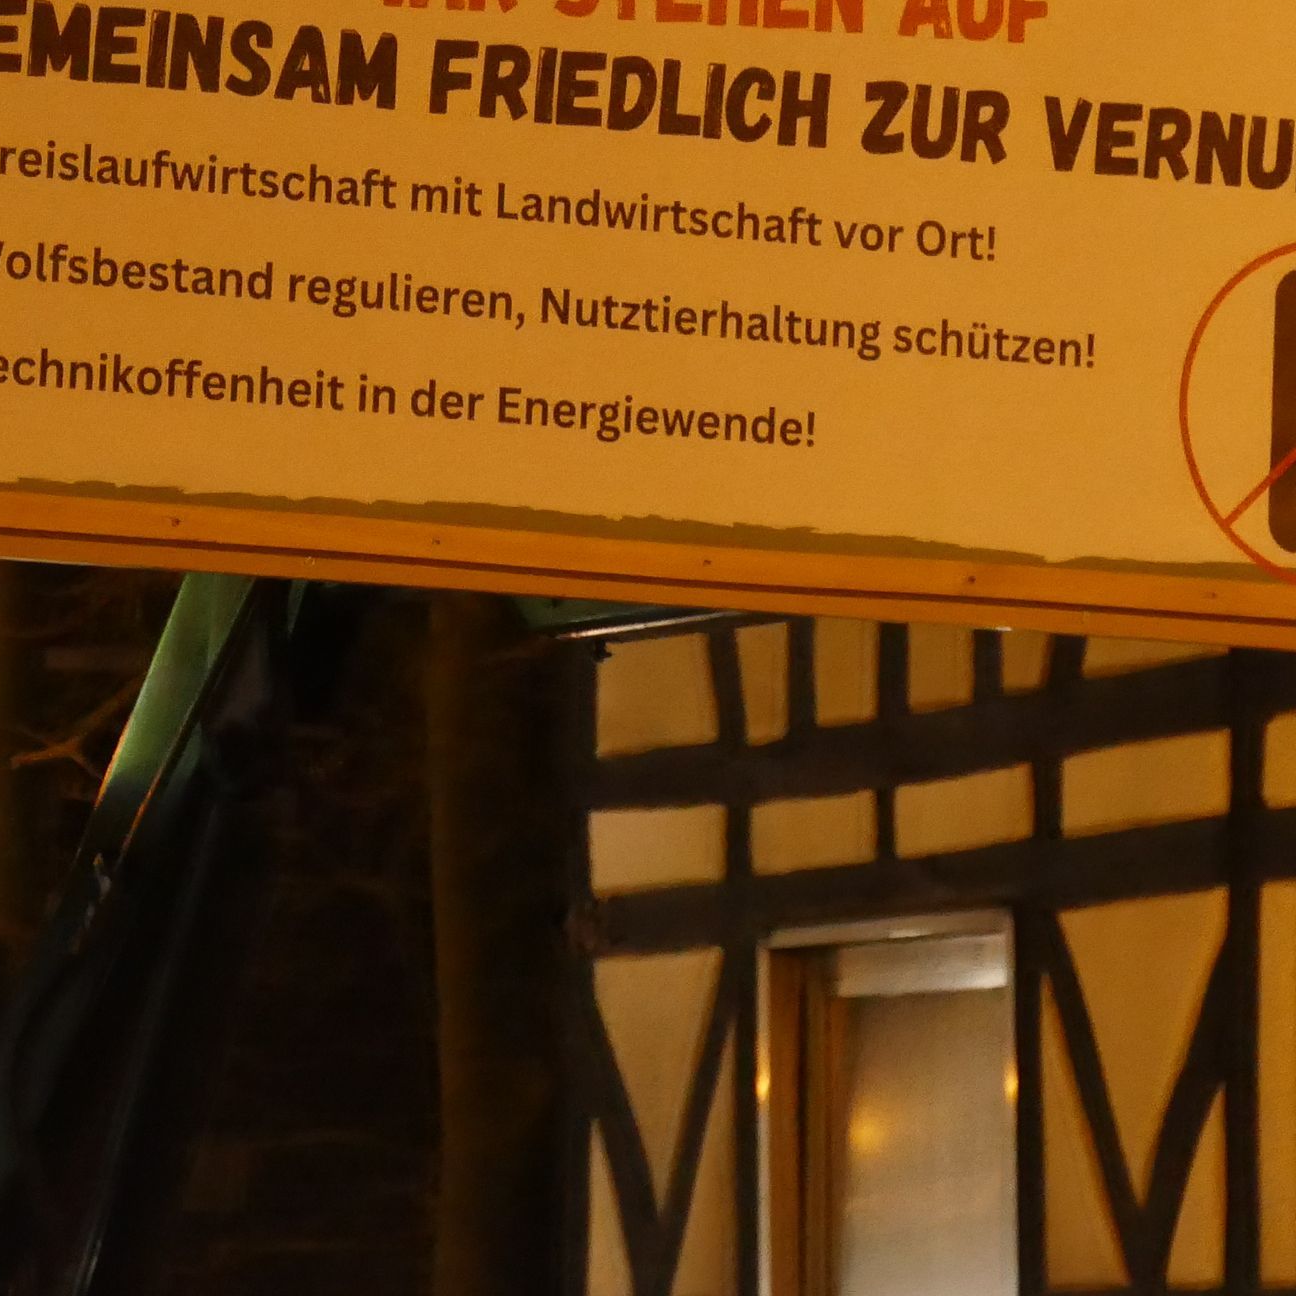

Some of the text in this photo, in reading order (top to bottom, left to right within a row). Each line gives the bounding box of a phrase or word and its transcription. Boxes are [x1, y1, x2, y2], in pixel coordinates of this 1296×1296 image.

[429, 39, 831, 148] FRIEDLICH
[861, 80, 1010, 165] ZUR
[411, 176, 482, 217] mit
[497, 182, 822, 246] Landwirtschaft
[834, 221, 904, 253] vor
[916, 220, 995, 261] Ort!
[289, 272, 525, 330] regulieren,
[540, 287, 881, 361] Nutztierhaltung
[893, 319, 1095, 368] schützen!
[358, 373, 396, 415] in
[411, 378, 485, 421] der
[498, 387, 815, 447] Energiewende!
